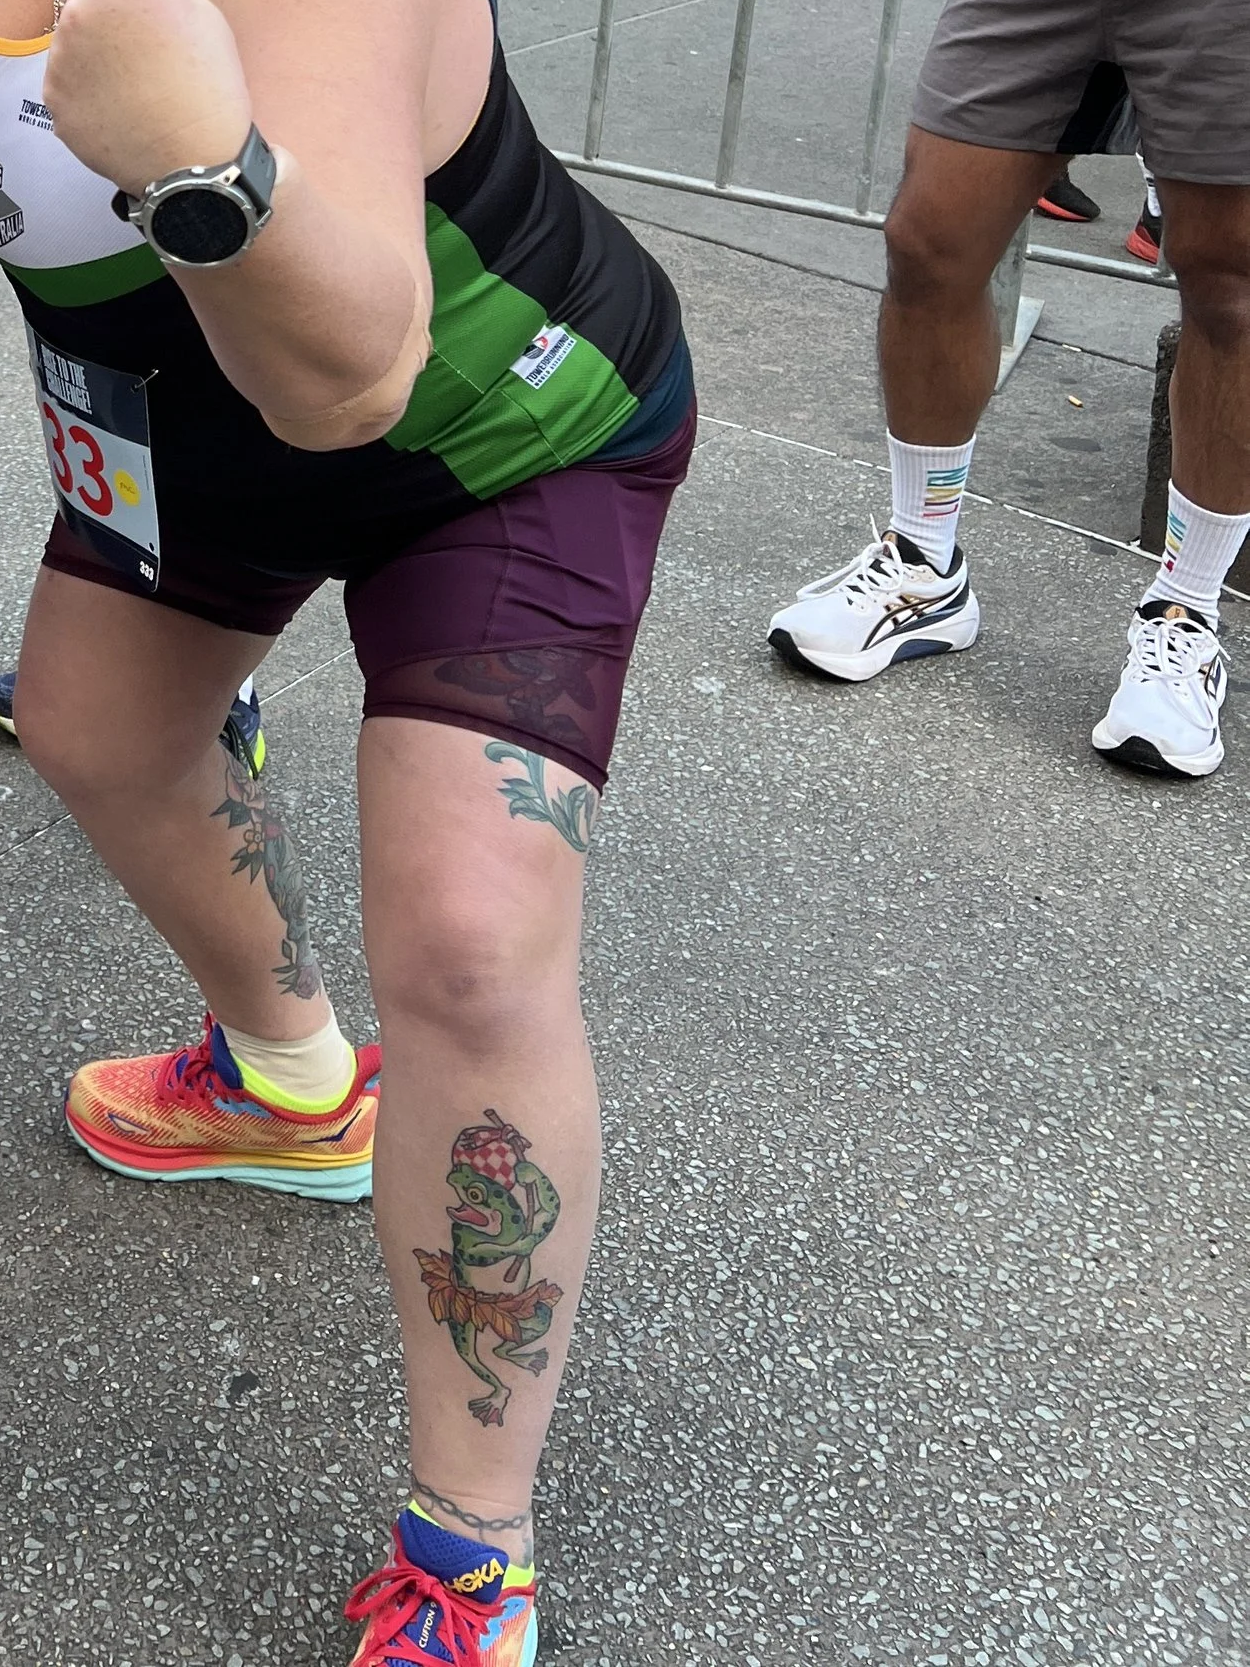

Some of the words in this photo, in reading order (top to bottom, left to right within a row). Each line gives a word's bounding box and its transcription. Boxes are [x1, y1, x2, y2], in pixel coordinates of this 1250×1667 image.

[525, 333, 570, 383] TOWERRUNNING
[444, 1558, 504, 1593] HOKA
[418, 1609, 435, 1648] CLIFTON
